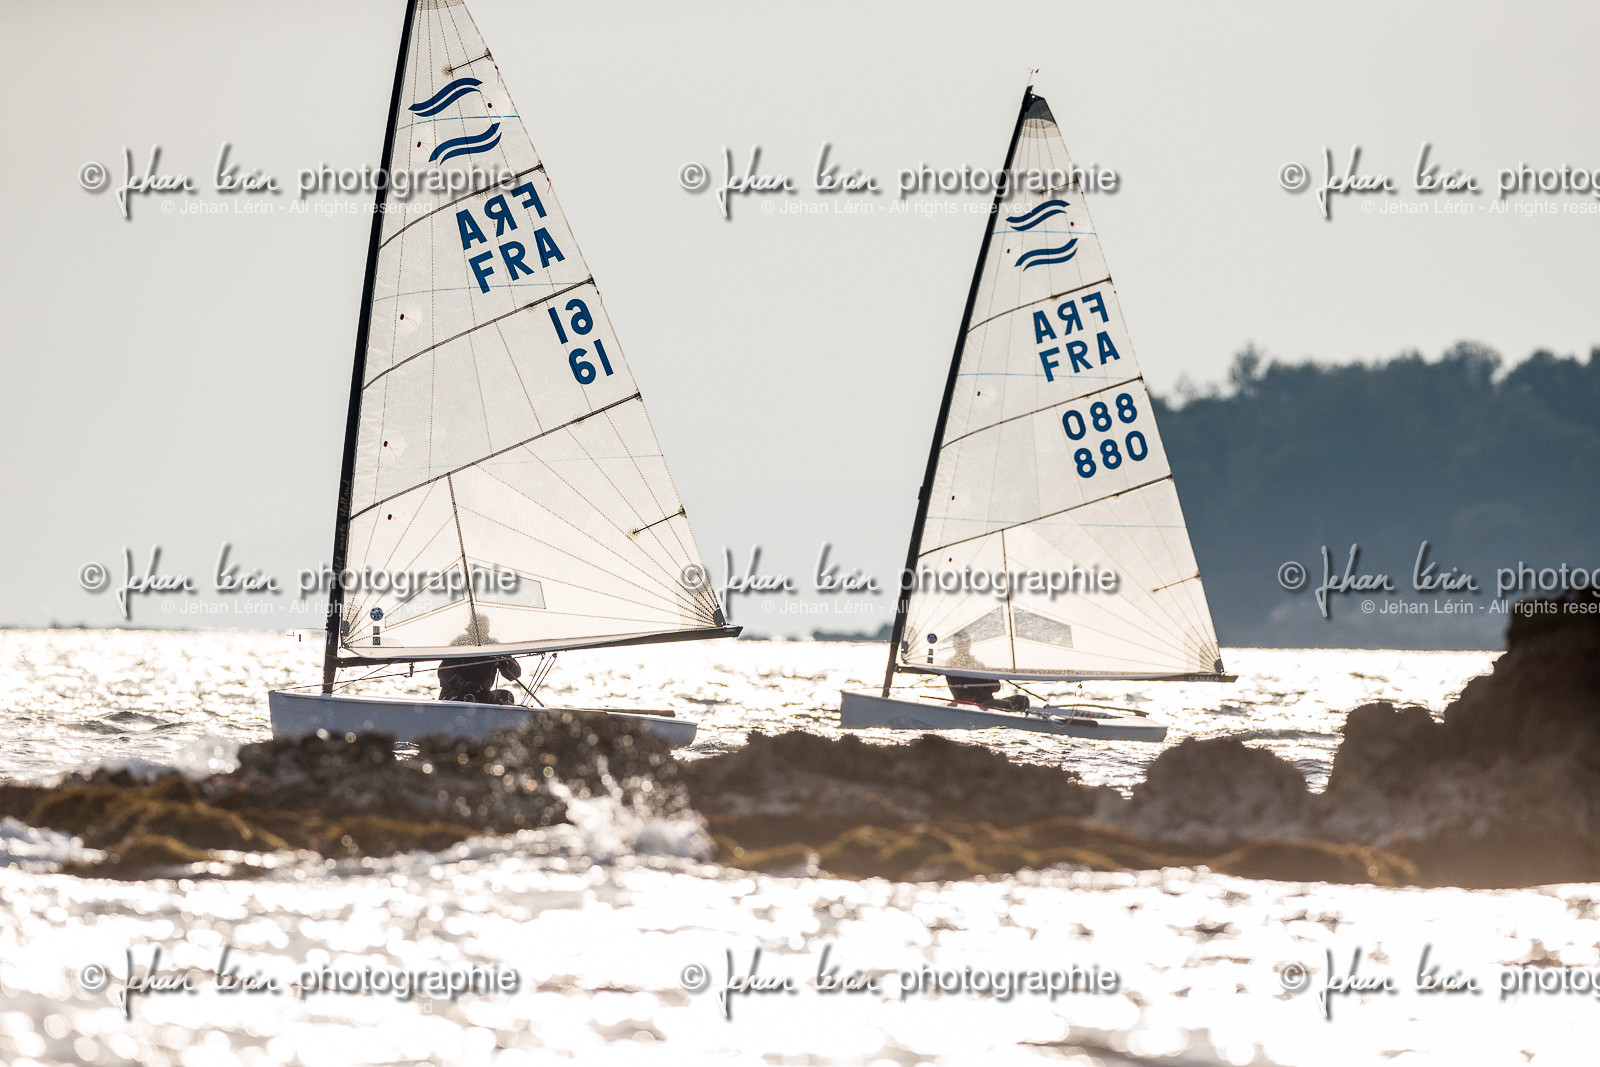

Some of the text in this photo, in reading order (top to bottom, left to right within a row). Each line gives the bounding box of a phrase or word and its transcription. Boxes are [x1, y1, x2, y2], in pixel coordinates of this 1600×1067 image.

[468, 227, 565, 294] FRA
[569, 338, 614, 385] 61
[1039, 331, 1120, 383] FRA
[1074, 430, 1148, 478] 880
[340, 479, 352, 518] Holland
